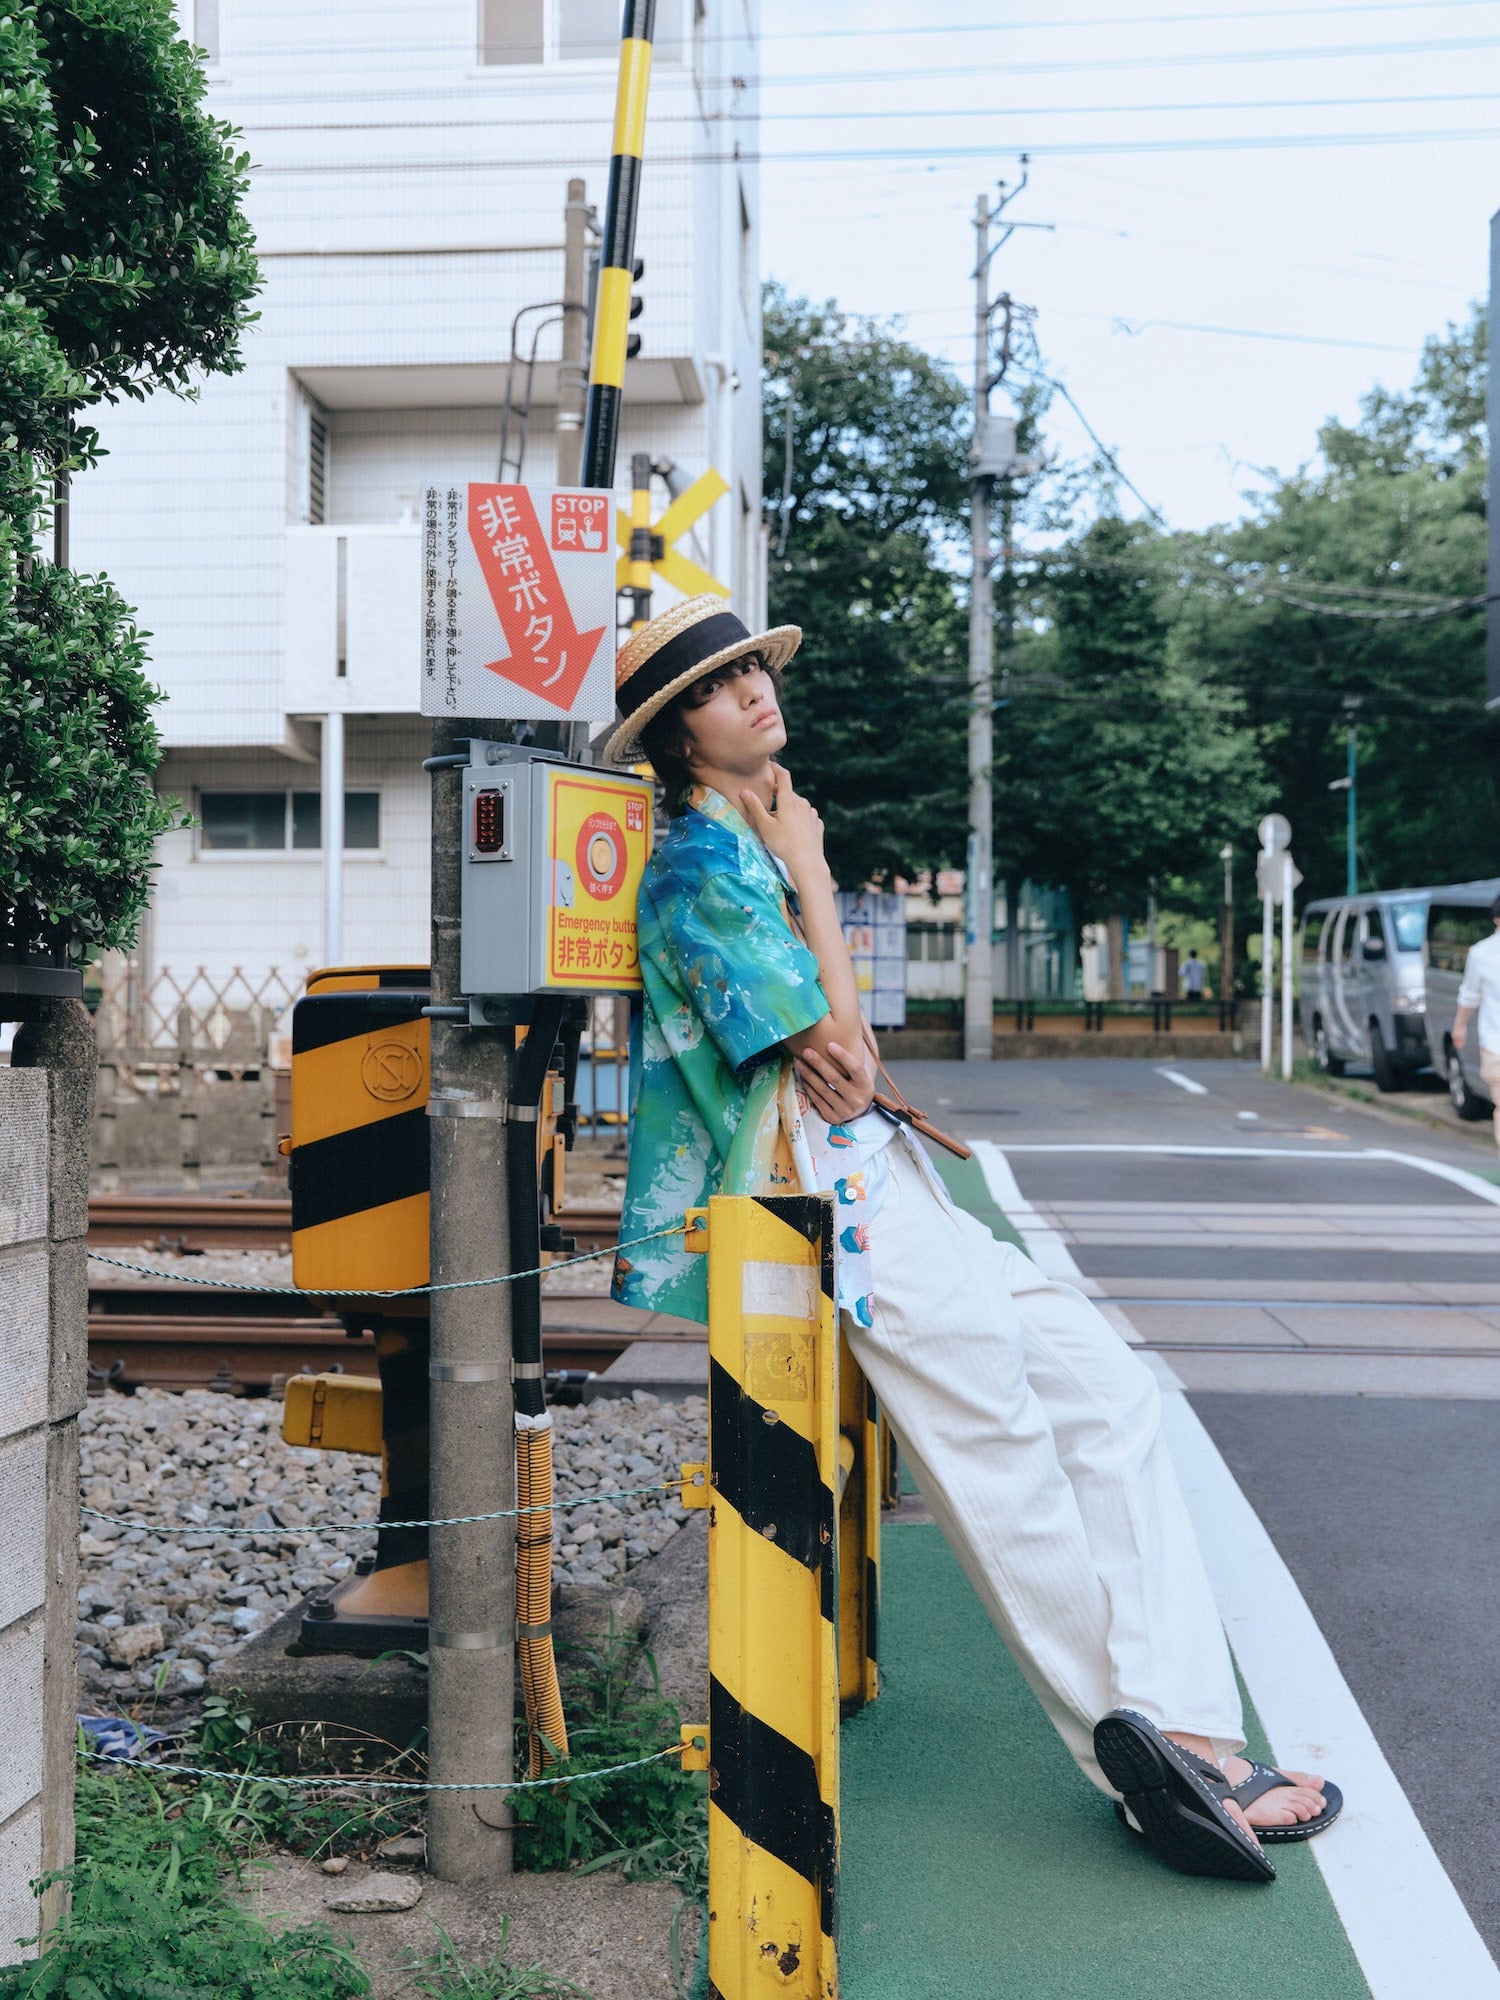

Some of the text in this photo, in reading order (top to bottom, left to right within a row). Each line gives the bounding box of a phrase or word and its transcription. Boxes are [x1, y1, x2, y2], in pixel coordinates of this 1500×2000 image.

[556, 498, 605, 514] STOP
[477, 495, 567, 687] 非常ボタン
[627, 801, 642, 811] STOP
[589, 882, 613, 894] 強く押す
[558, 913, 638, 935] Emergency butto
[558, 936, 639, 969] 非常ボタン
